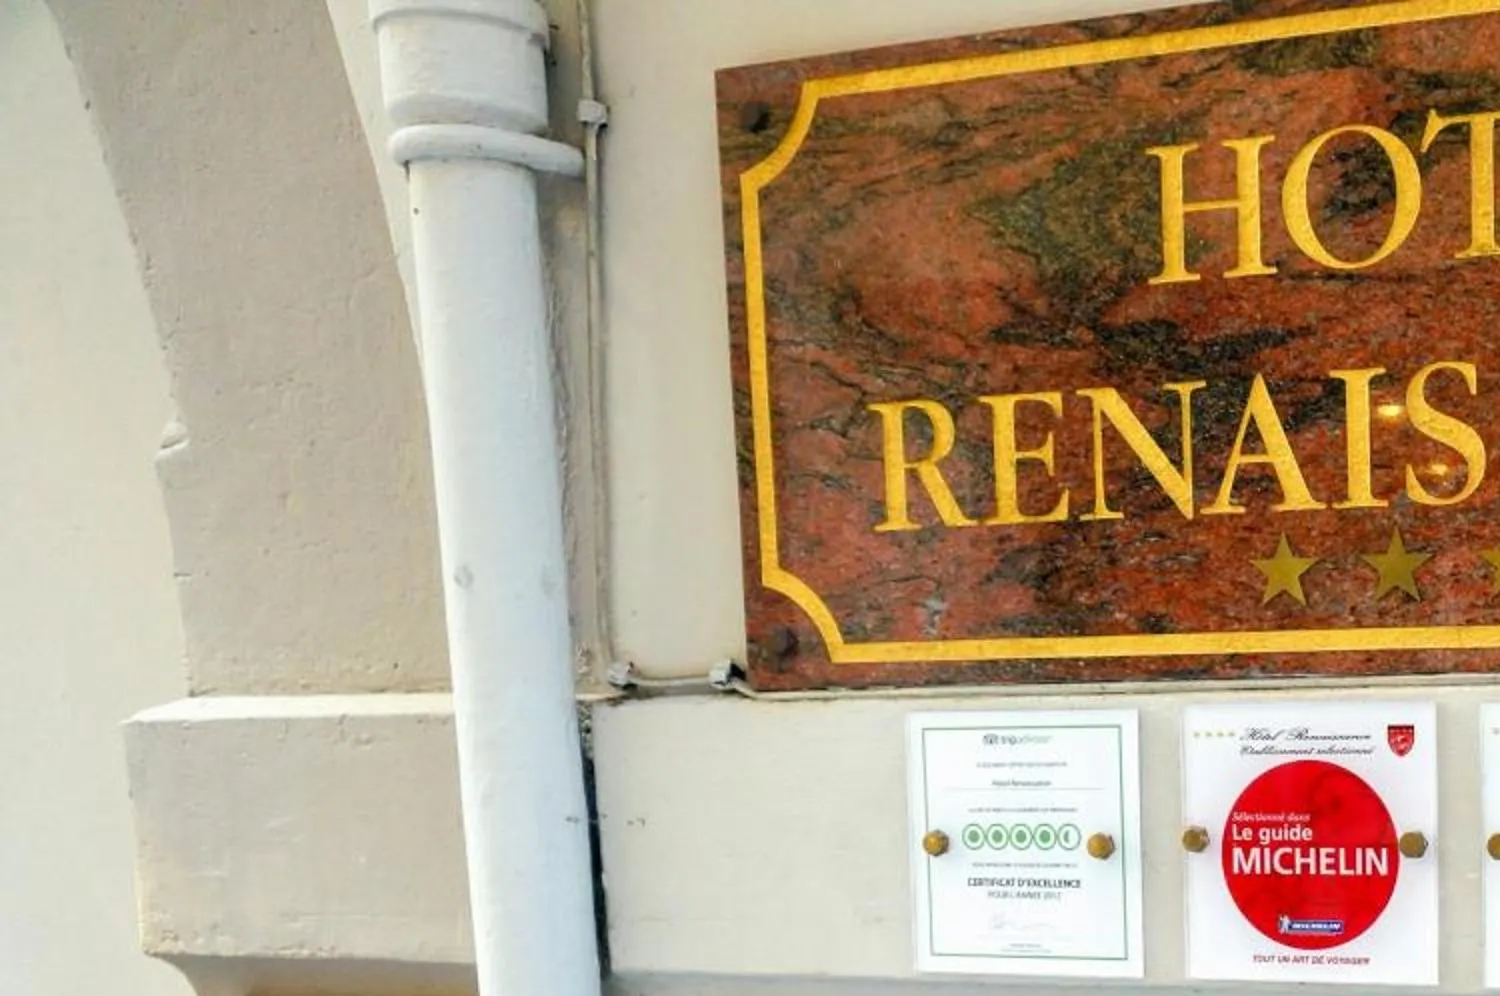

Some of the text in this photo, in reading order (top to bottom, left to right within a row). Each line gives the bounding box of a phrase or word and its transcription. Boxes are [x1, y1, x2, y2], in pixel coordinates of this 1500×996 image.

[1232, 824, 1313, 845] Le guide
[1232, 847, 1388, 876] MICHELIN
